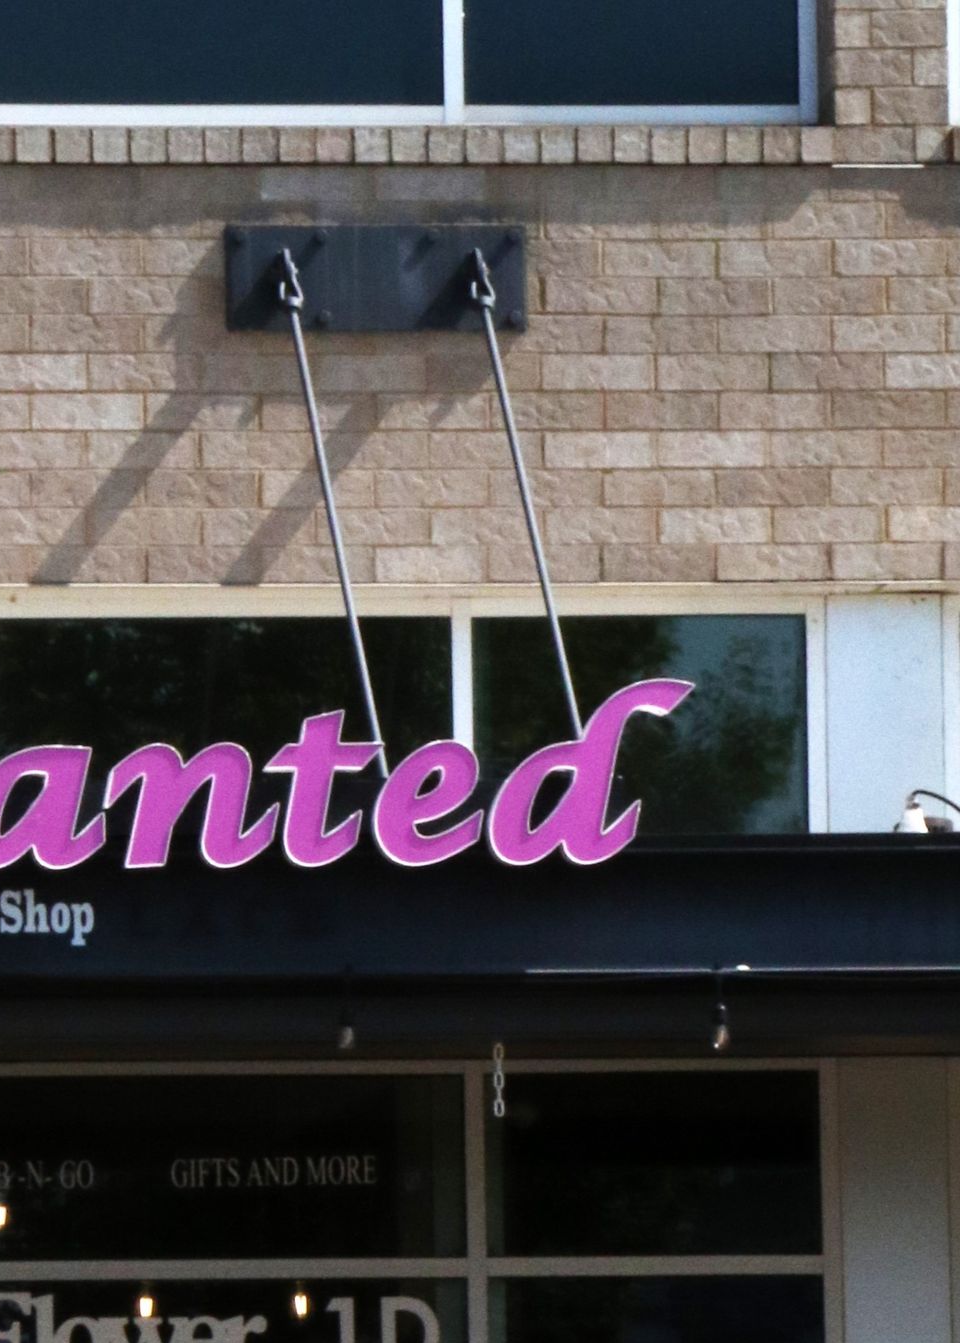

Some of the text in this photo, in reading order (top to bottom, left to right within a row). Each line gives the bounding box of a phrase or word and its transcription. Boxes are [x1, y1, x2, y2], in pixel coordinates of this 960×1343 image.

[0, 888, 95, 946] Shop
[59, 1160, 95, 1189] GO
[170, 1155, 377, 1188] GIFTS AND MORE
